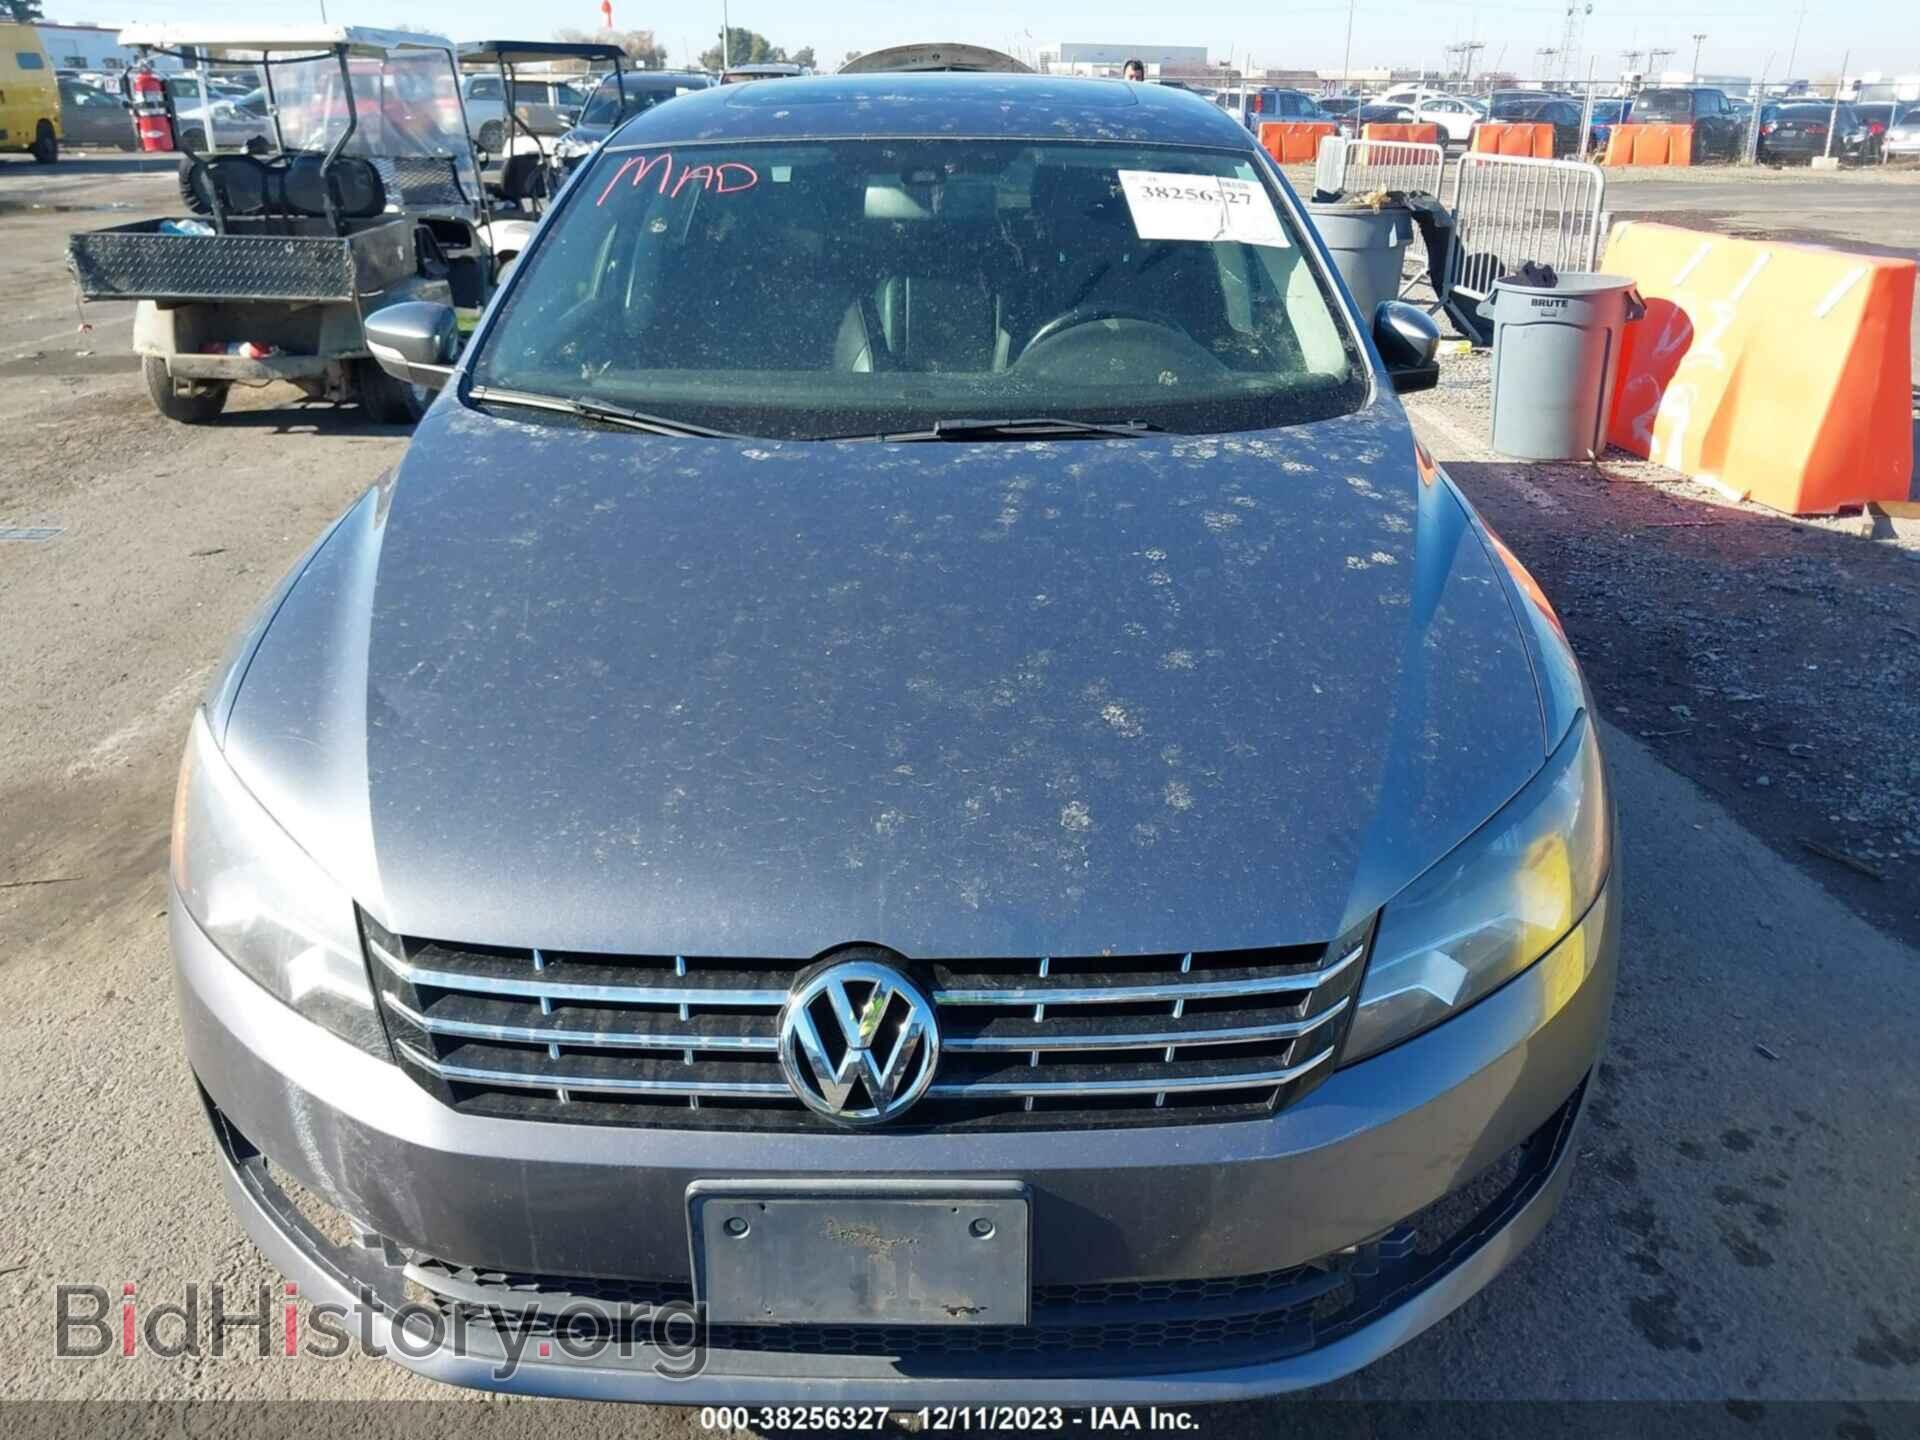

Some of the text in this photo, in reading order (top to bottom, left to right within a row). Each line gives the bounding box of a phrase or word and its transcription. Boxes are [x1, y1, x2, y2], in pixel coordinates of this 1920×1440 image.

[596, 153, 758, 206] MAD
[1141, 185, 1252, 206] 38256327
[1531, 298, 1568, 308] BRUTE
[781, 963, 938, 1121] VW
